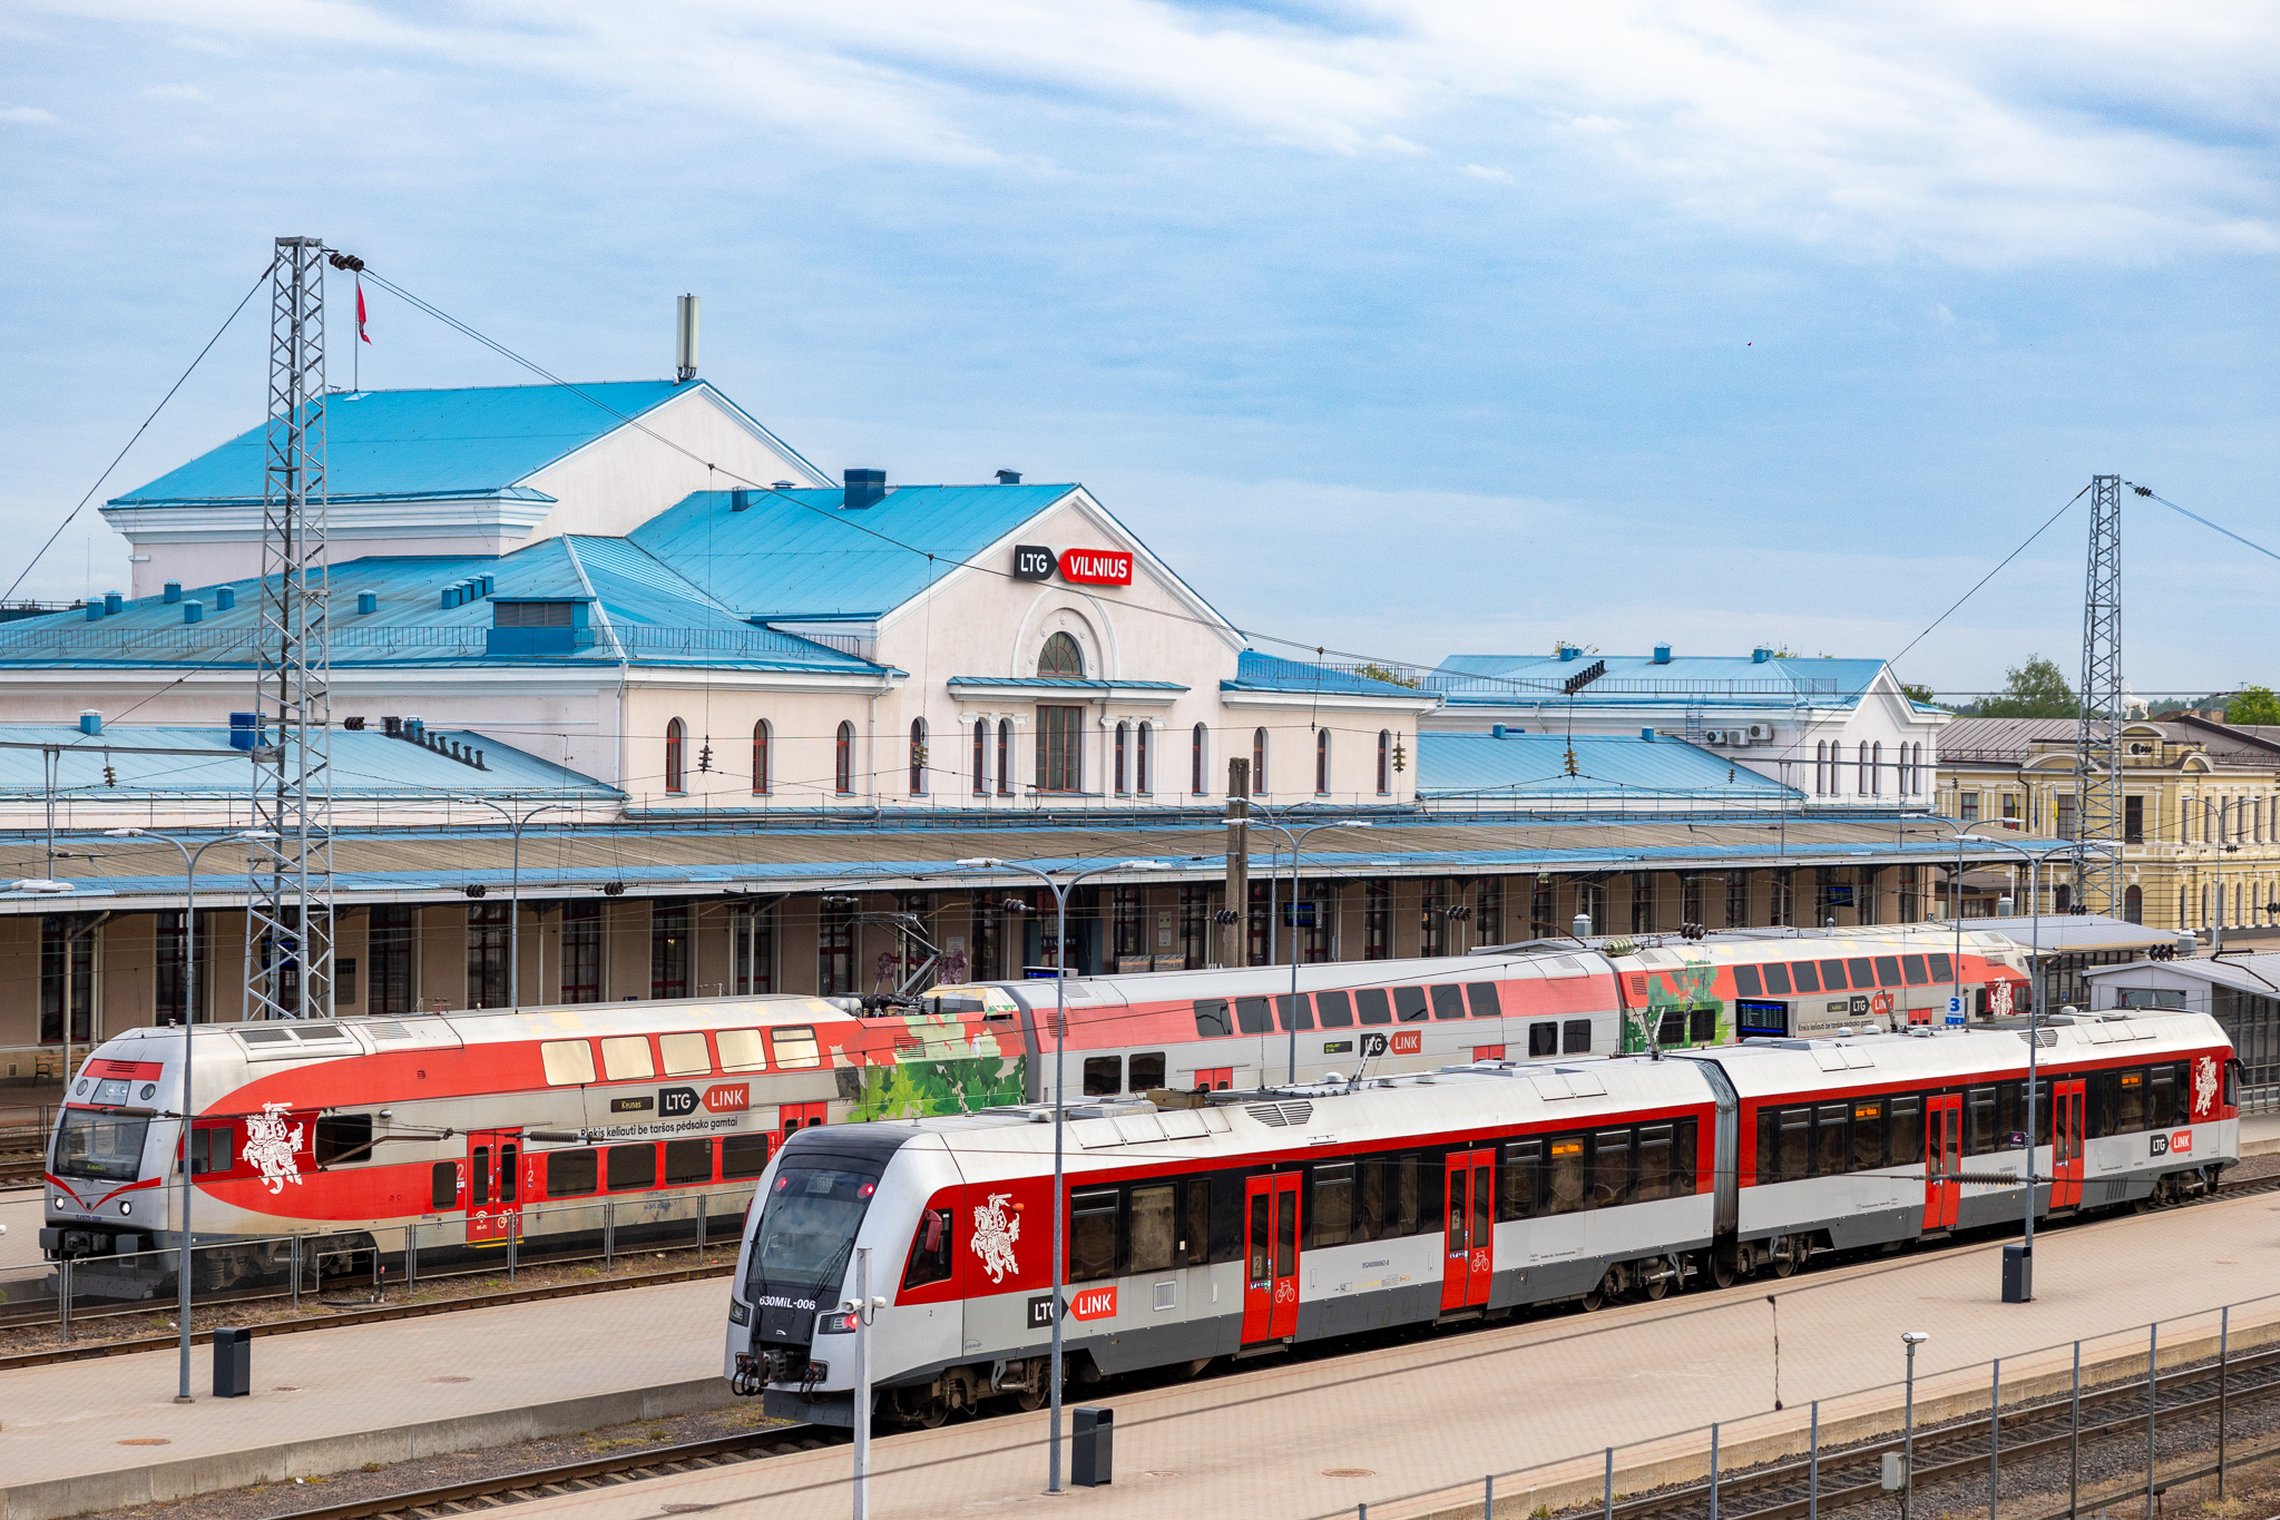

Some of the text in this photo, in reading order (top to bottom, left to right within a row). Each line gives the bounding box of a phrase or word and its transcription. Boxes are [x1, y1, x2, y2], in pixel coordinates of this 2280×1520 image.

[1020, 553, 1128, 579] LTG VILNIUS
[1853, 1000, 1866, 1011] LTG
[1950, 997, 1960, 1011] 3
[1395, 1036, 1418, 1050] LINK
[666, 1089, 744, 1111] LTG LINK
[607, 1125, 637, 1138] keliauti
[638, 1124, 648, 1135] be
[650, 1123, 675, 1134] taršos
[676, 1119, 709, 1134] pėdsako
[711, 1116, 738, 1131] gamtai
[2153, 1135, 2190, 1152] LTG LINK
[528, 1157, 533, 1169] 1
[456, 1164, 464, 1181] 2
[528, 1170, 534, 1181] 2
[759, 1296, 816, 1310] 630MiL-006
[1079, 1294, 1112, 1315] LINK
